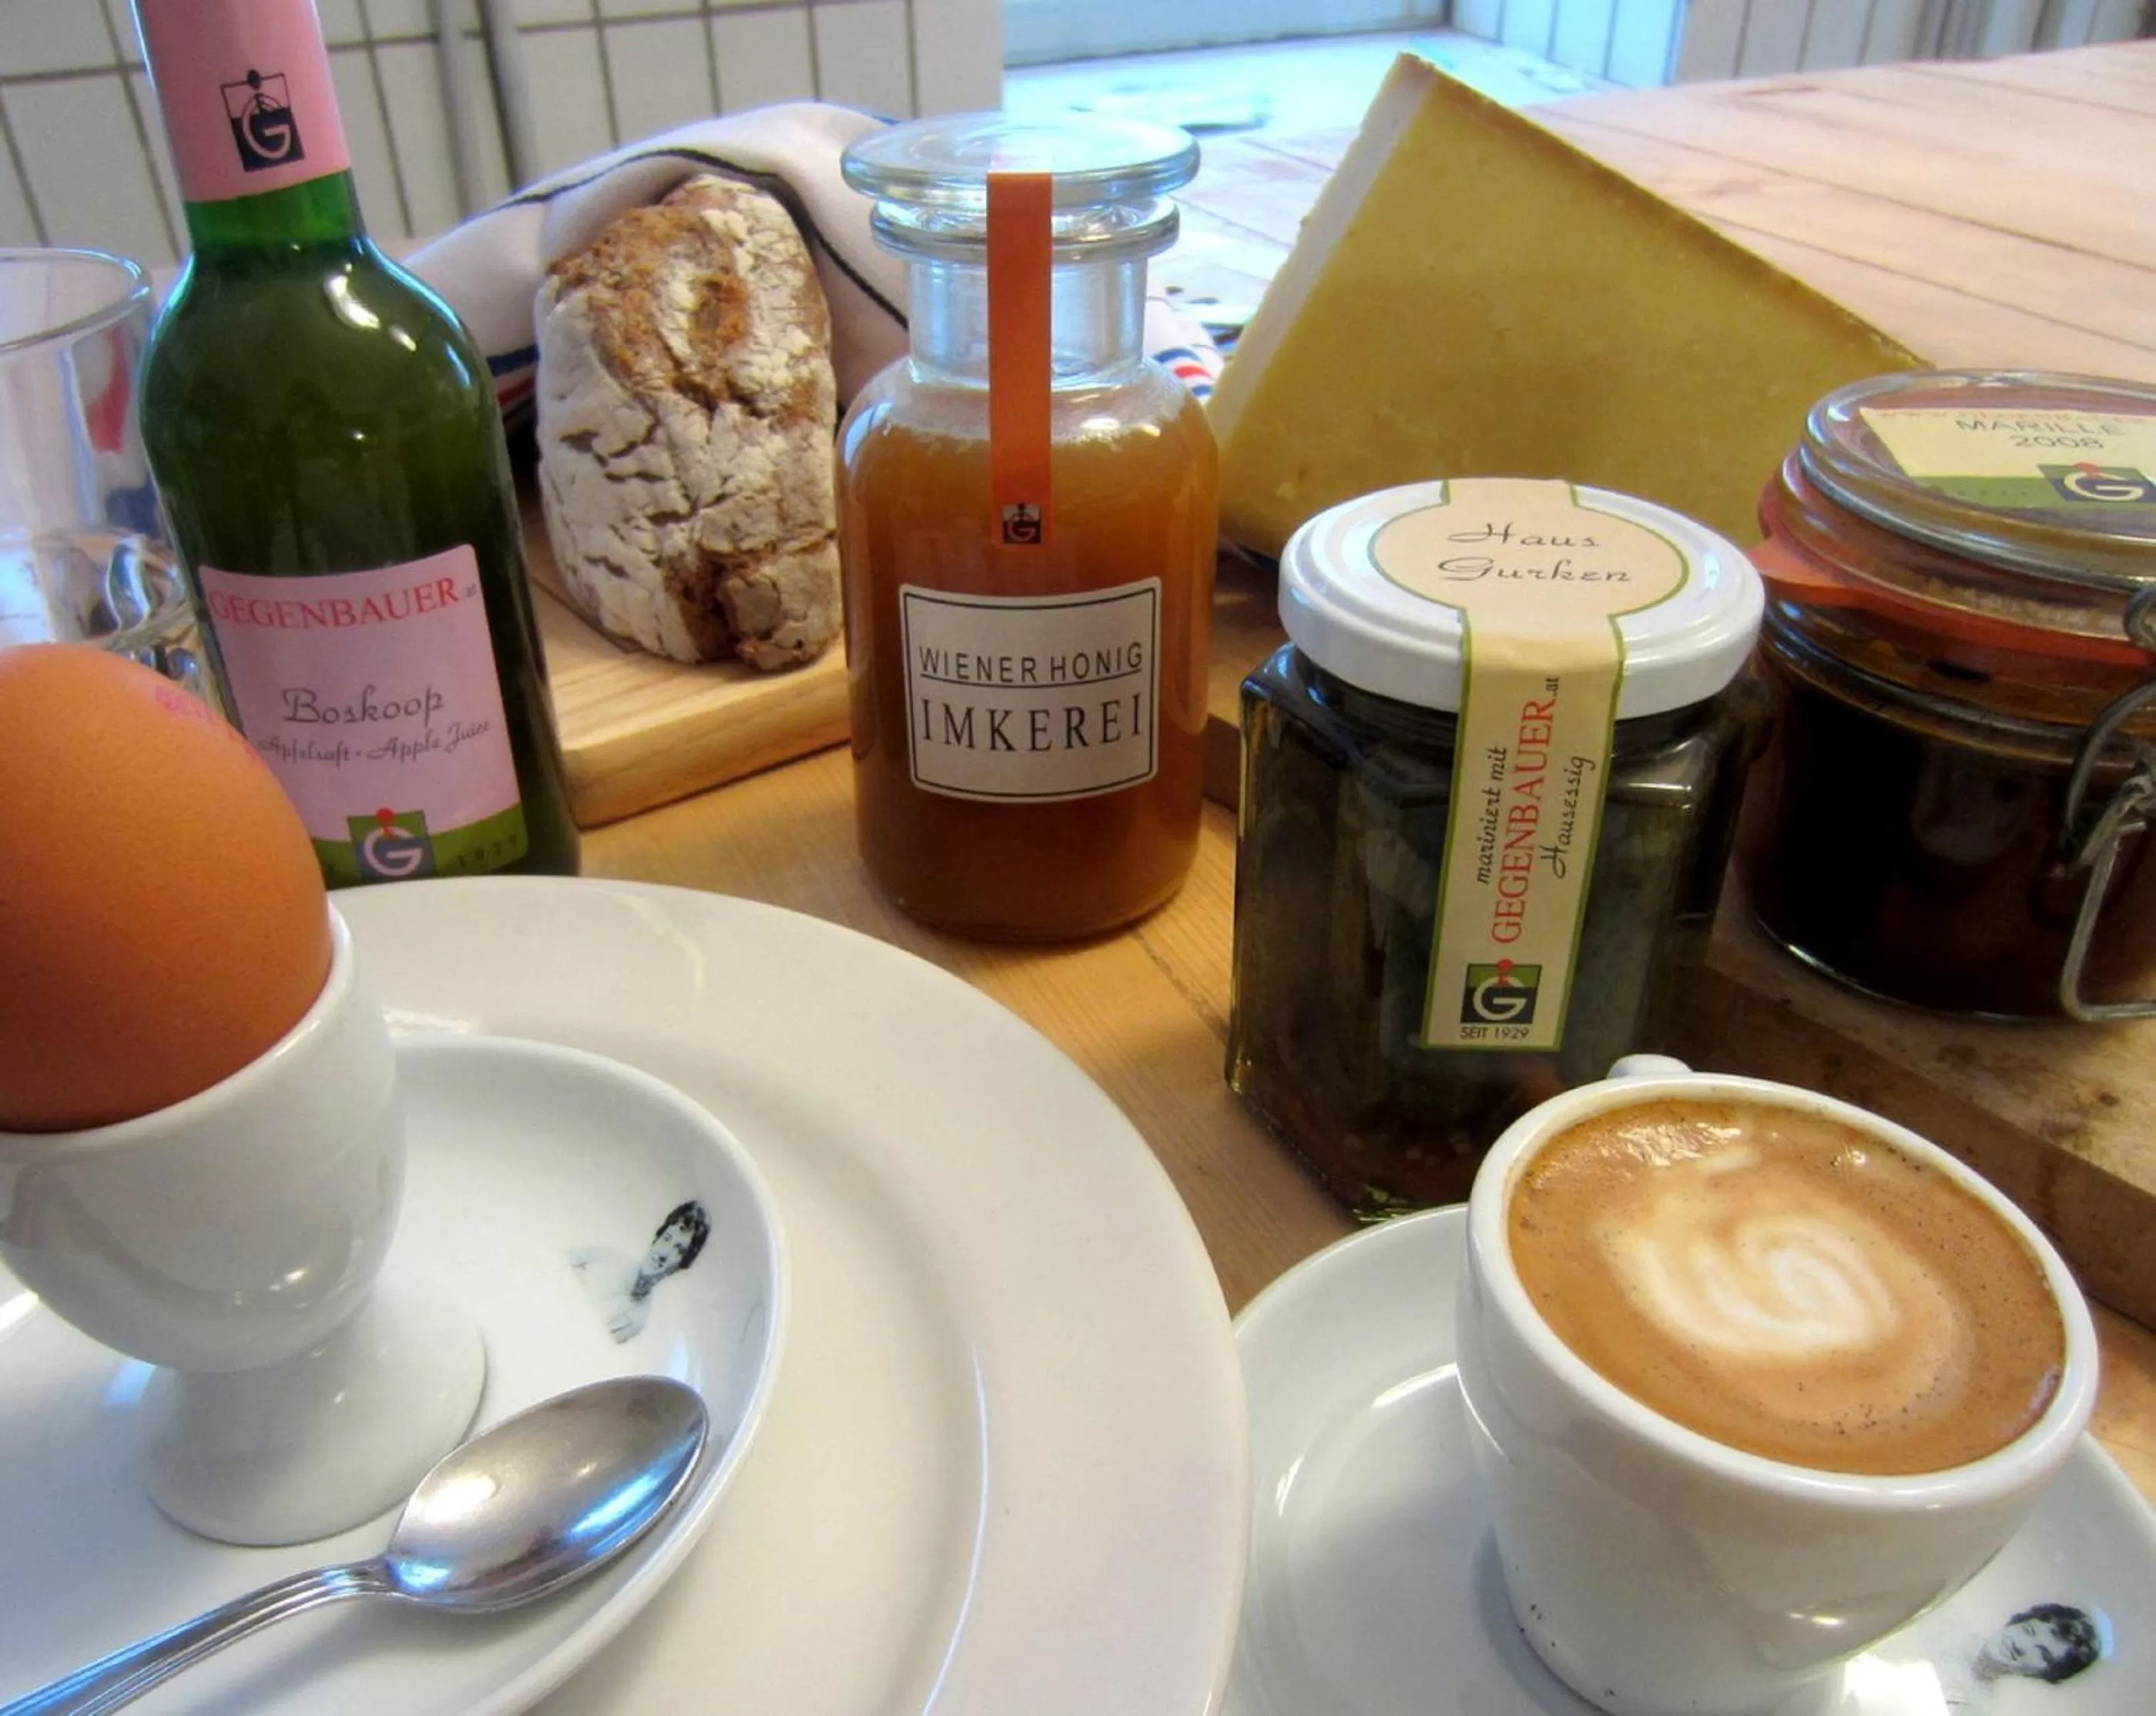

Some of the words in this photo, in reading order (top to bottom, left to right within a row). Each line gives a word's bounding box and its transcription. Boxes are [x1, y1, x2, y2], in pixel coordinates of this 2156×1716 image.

[1956, 420, 2124, 436] MARILLE
[2010, 435, 2104, 448] 2008
[1447, 521, 1600, 548] Haus
[1438, 556, 1631, 582] Gurken
[920, 645, 1038, 684] WIENER
[1050, 642, 1143, 681] HONIG
[280, 683, 446, 729] Boskoop
[921, 694, 1141, 752] IMKEREI
[367, 728, 441, 763] Apple
[444, 720, 491, 753] Juice
[1487, 746, 1507, 783] mit
[1477, 786, 1502, 884] mariniert
[1541, 756, 1596, 879] Hausessig
[1460, 1026, 1487, 1039] SEIT
[1494, 1026, 1530, 1039] 1929
